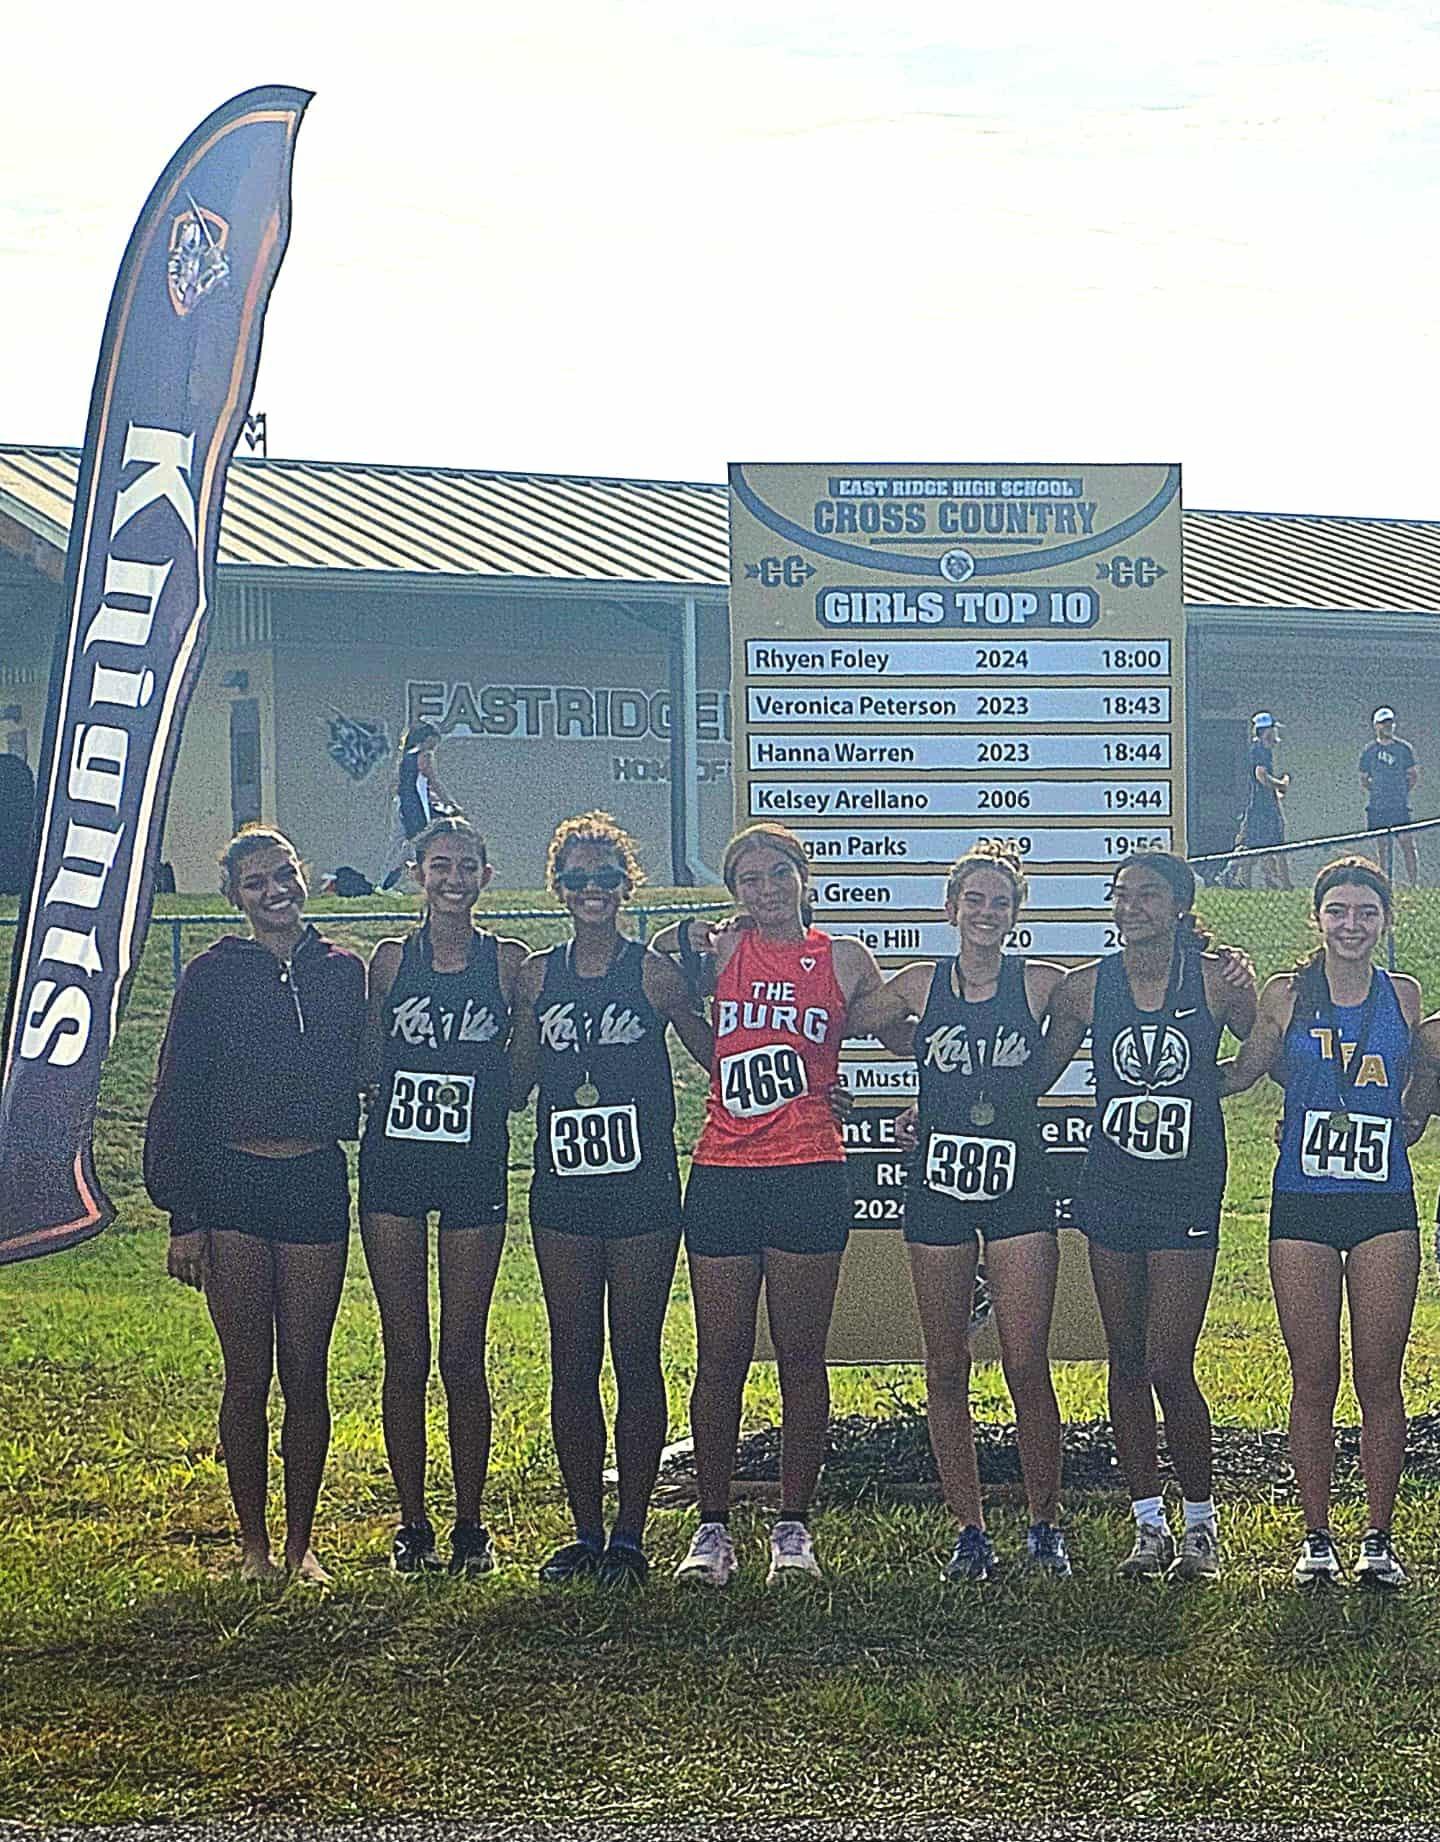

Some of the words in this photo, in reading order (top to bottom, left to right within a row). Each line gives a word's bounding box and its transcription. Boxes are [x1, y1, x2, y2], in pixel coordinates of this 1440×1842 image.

[839, 480, 887, 497] EAST
[890, 480, 948, 497] RIDGE
[952, 480, 997, 497] HIGH
[1001, 480, 1073, 497] SCHOOL
[814, 501, 926, 534] CROSS
[938, 501, 1097, 534] COUNTRY
[824, 592, 945, 625] GIRLS
[957, 592, 1037, 624] TOP
[1050, 592, 1092, 624] 10
[755, 650, 824, 672] Rhyen
[831, 650, 889, 672] Foley
[975, 650, 1028, 668] 2024
[1102, 650, 1161, 668] 18:00
[757, 697, 853, 716] Veronica
[860, 697, 956, 716] Peterson
[976, 697, 1029, 715] 2023
[1102, 697, 1161, 715] 18:43
[21, 421, 197, 1067] Knights
[758, 743, 829, 763] Hanna
[833, 743, 914, 763] Warren
[977, 743, 1029, 762] 2023
[1103, 743, 1161, 762] 18:44
[758, 790, 830, 814] Kelsey
[835, 789, 928, 809] Arellano
[977, 790, 1030, 809] 2006
[1103, 790, 1162, 809] 19:44
[848, 836, 907, 856] Parks
[824, 883, 890, 902] Green
[884, 929, 920, 948] Hill
[1003, 930, 1032, 948] 20
[751, 981, 796, 1001] THE
[717, 1000, 829, 1045] BURG
[725, 1049, 804, 1110] 469
[391, 1077, 470, 1132] 383
[556, 1112, 636, 1168] 380
[1106, 1101, 1187, 1154] 493
[1305, 1118, 1386, 1174] 445
[931, 1140, 1011, 1196] 386
